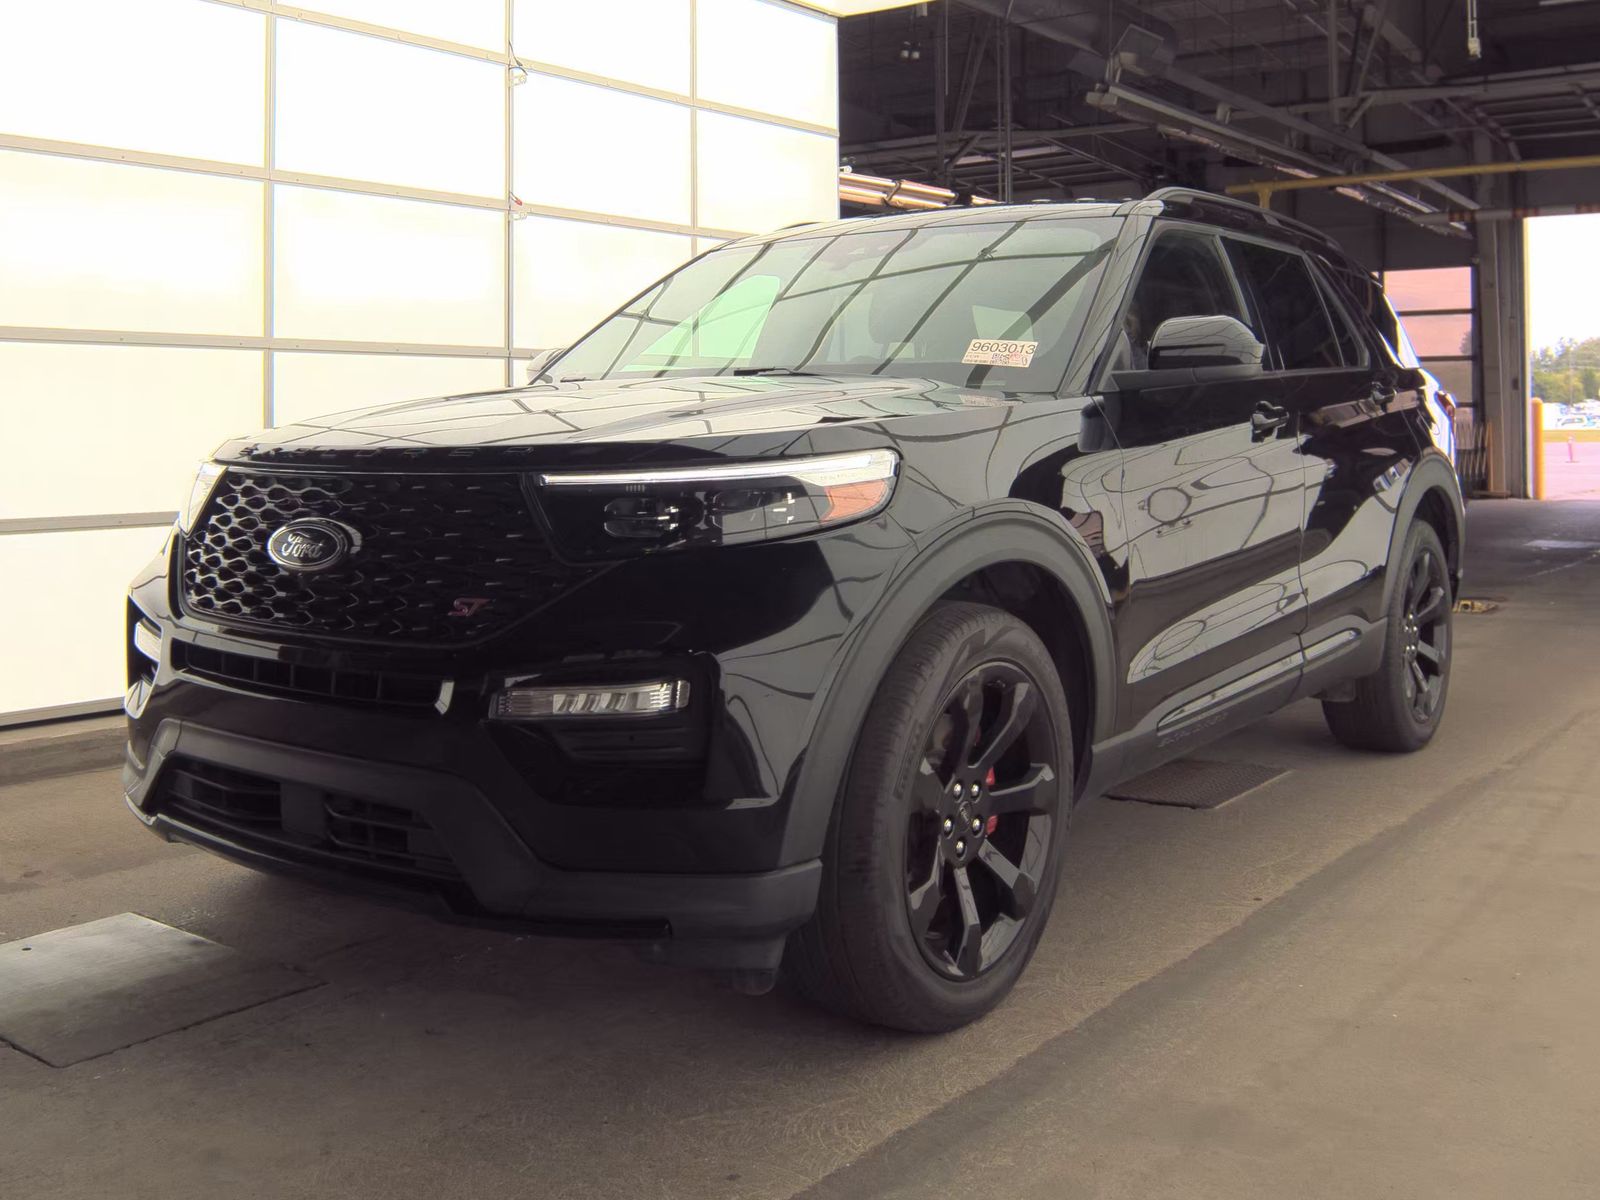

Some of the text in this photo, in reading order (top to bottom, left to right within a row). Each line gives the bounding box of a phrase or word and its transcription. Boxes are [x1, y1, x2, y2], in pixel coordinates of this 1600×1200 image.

[971, 341, 1036, 355] 9603013
[281, 531, 324, 558] Ford
[448, 598, 490, 616] ST
